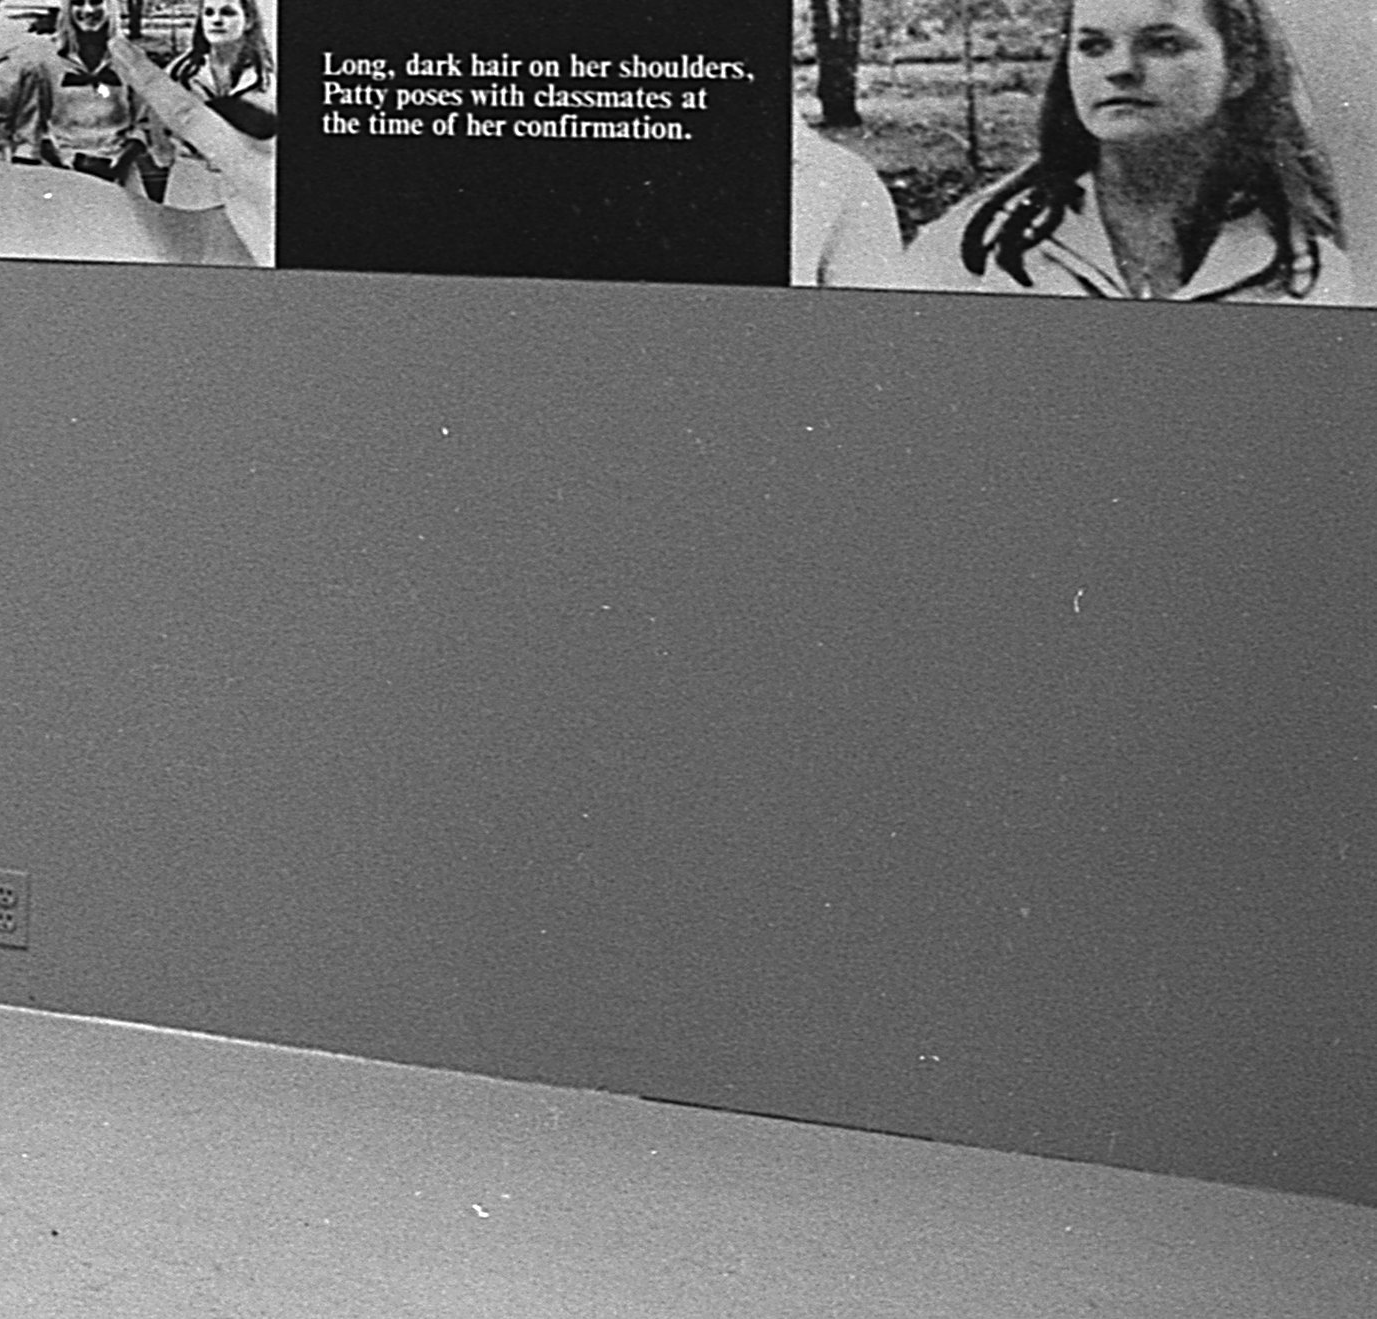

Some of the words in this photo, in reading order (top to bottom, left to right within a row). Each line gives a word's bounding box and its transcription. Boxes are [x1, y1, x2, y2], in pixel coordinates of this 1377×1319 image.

[323, 51, 396, 84] Long,
[405, 52, 463, 77] dark
[470, 52, 523, 78] hair
[528, 59, 560, 78] on
[570, 53, 613, 78] her
[618, 53, 755, 82] shoulders,
[323, 81, 389, 113] Patty
[396, 88, 464, 114] poses
[470, 82, 525, 108] with
[533, 83, 673, 109] classmates
[681, 87, 708, 110] at
[322, 110, 361, 135] the
[368, 111, 424, 136] time
[431, 111, 460, 136] of
[466, 112, 508, 137] her
[513, 113, 693, 140] confirmation.
